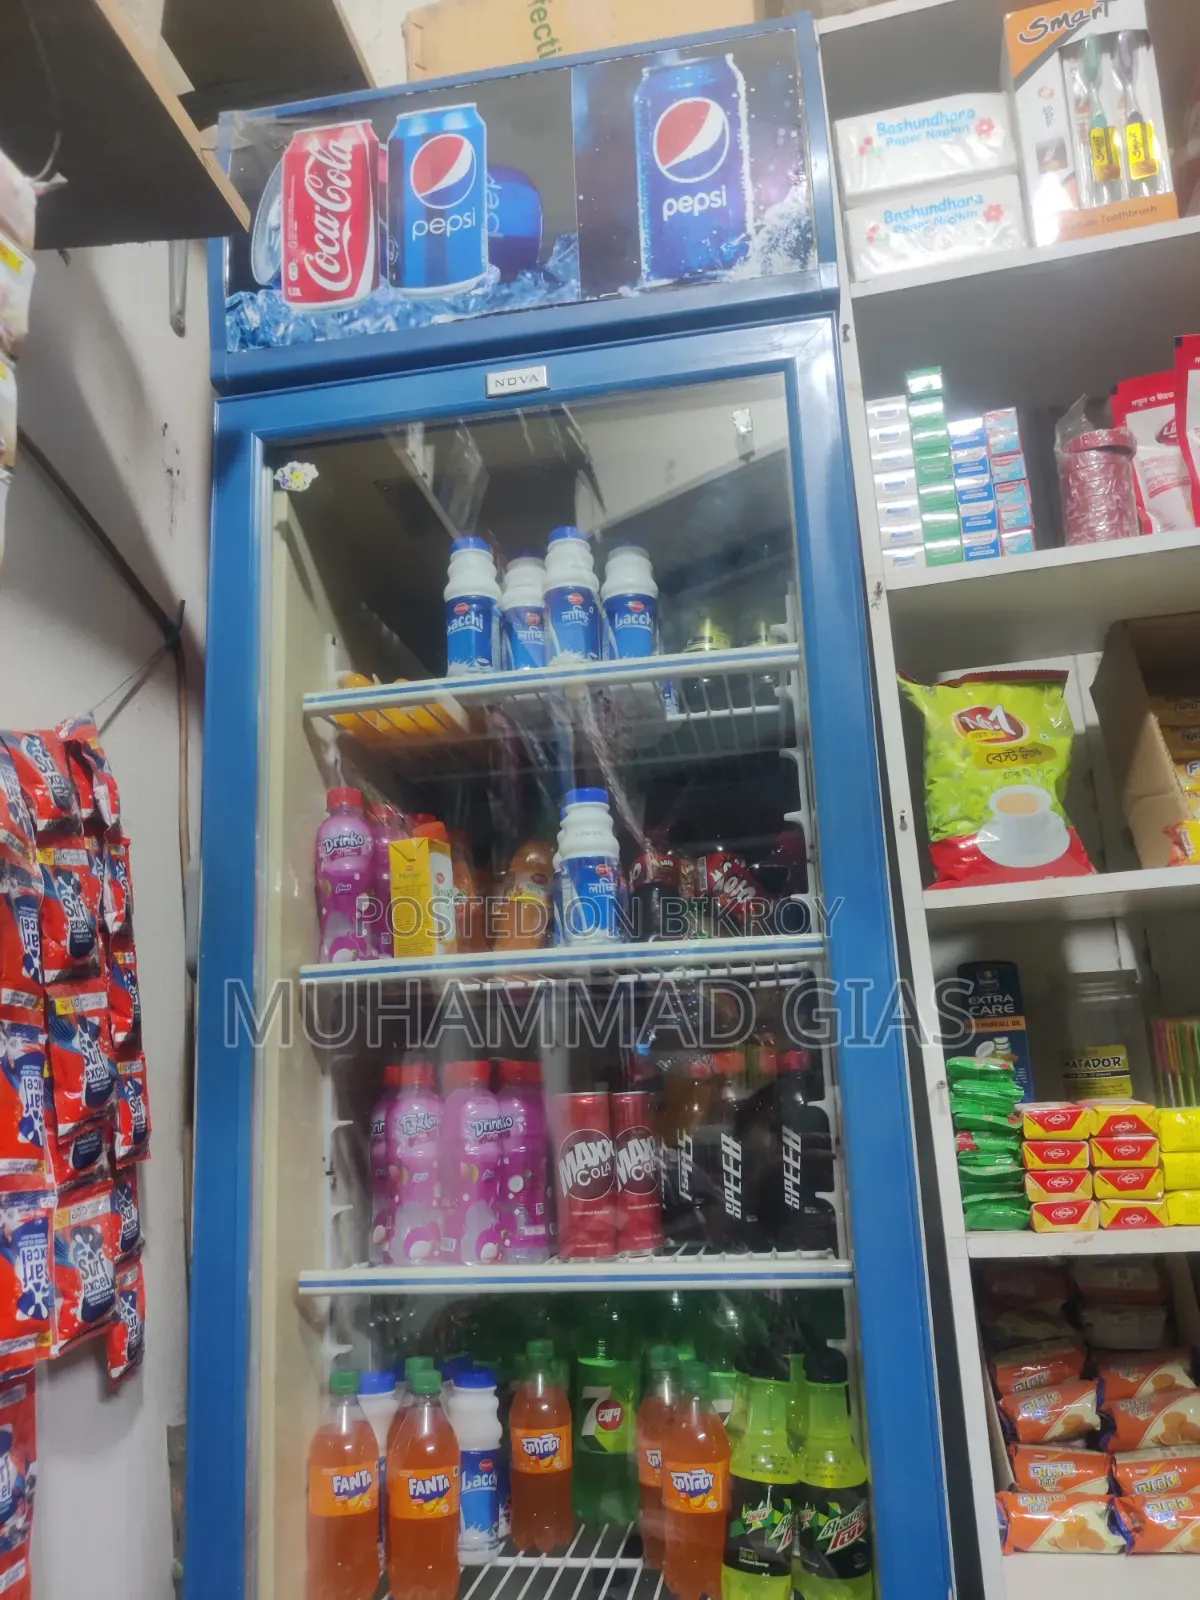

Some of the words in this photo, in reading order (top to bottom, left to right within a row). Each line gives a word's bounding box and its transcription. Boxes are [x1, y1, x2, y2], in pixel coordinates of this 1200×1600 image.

[877, 108, 975, 137] Bashundhara
[886, 134, 920, 148] Paper
[925, 124, 970, 139] Napkin
[662, 186, 727, 221] pepsi
[884, 194, 983, 223] Bashundhara
[412, 207, 476, 241] pepsi
[495, 374, 540, 388] NOVA
[323, 832, 365, 854] Drinko
[968, 994, 1014, 1005] EXTRA
[969, 1003, 1015, 1016] CARE
[472, 1116, 513, 1137] Drinko
[559, 1139, 615, 1197] MAXX
[577, 1162, 611, 1186] COLA
[721, 1132, 742, 1220] SPEED
[782, 1125, 802, 1211] SPEED
[79, 1251, 107, 1280] Surf
[84, 1275, 112, 1295] excel
[521, 1433, 561, 1455] ফ্যান্টা
[333, 1470, 373, 1494] FANTA
[409, 1474, 450, 1497] FANTA
[670, 1469, 714, 1492] ফ্যান্টা
